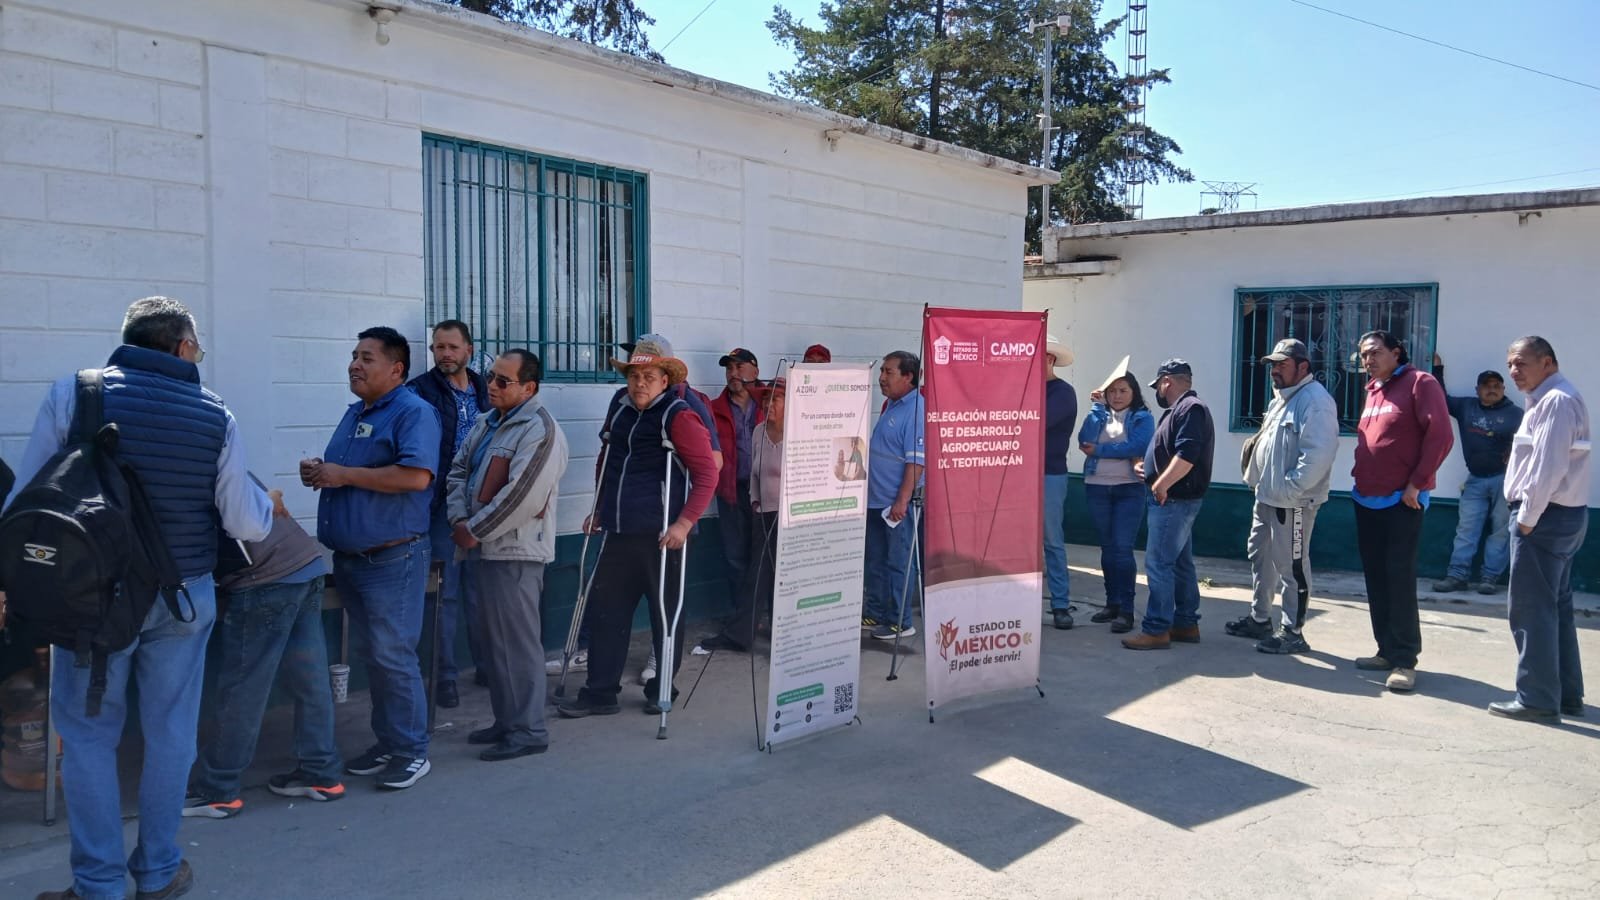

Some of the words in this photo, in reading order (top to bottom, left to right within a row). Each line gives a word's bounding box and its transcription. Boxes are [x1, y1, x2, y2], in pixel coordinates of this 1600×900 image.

[991, 342, 1035, 356] CAMPO
[953, 352, 978, 361] MÉXICO
[850, 383, 871, 392] SOMOS?
[927, 409, 987, 422] DELEGACIÓN
[989, 410, 1041, 421] REGIONAL
[940, 427, 954, 438] DE
[955, 426, 1022, 438] DESARROLLO
[941, 440, 1020, 453] AGROPECUARIO
[938, 458, 950, 469] IX.
[951, 453, 1023, 469] TEOTIHUACÁN
[969, 622, 1005, 634] ESTADO
[1008, 620, 1021, 629] DE
[955, 633, 1021, 656] MÉXICO
[949, 660, 958, 675] ¡El
[982, 653, 993, 665] de
[994, 651, 1021, 663] servir!
